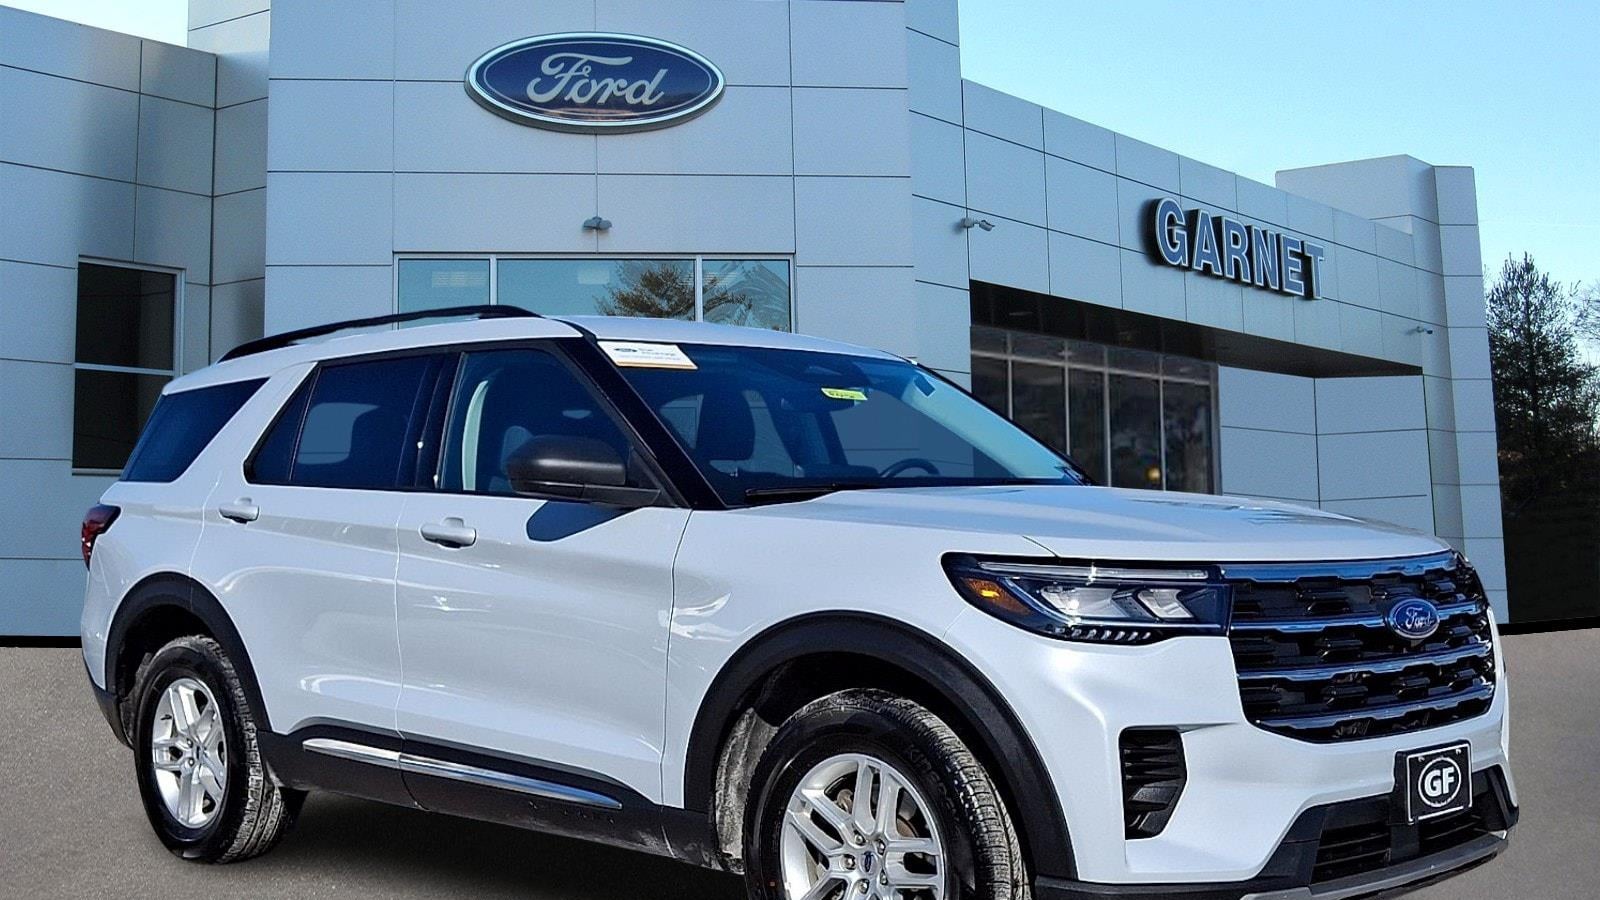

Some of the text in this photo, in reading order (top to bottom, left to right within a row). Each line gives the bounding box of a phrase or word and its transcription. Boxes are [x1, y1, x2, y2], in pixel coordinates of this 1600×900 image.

[526, 52, 668, 105] Ford
[1154, 197, 1325, 300] GARNET
[1405, 606, 1435, 630] Ford
[1424, 766, 1455, 797] GF
